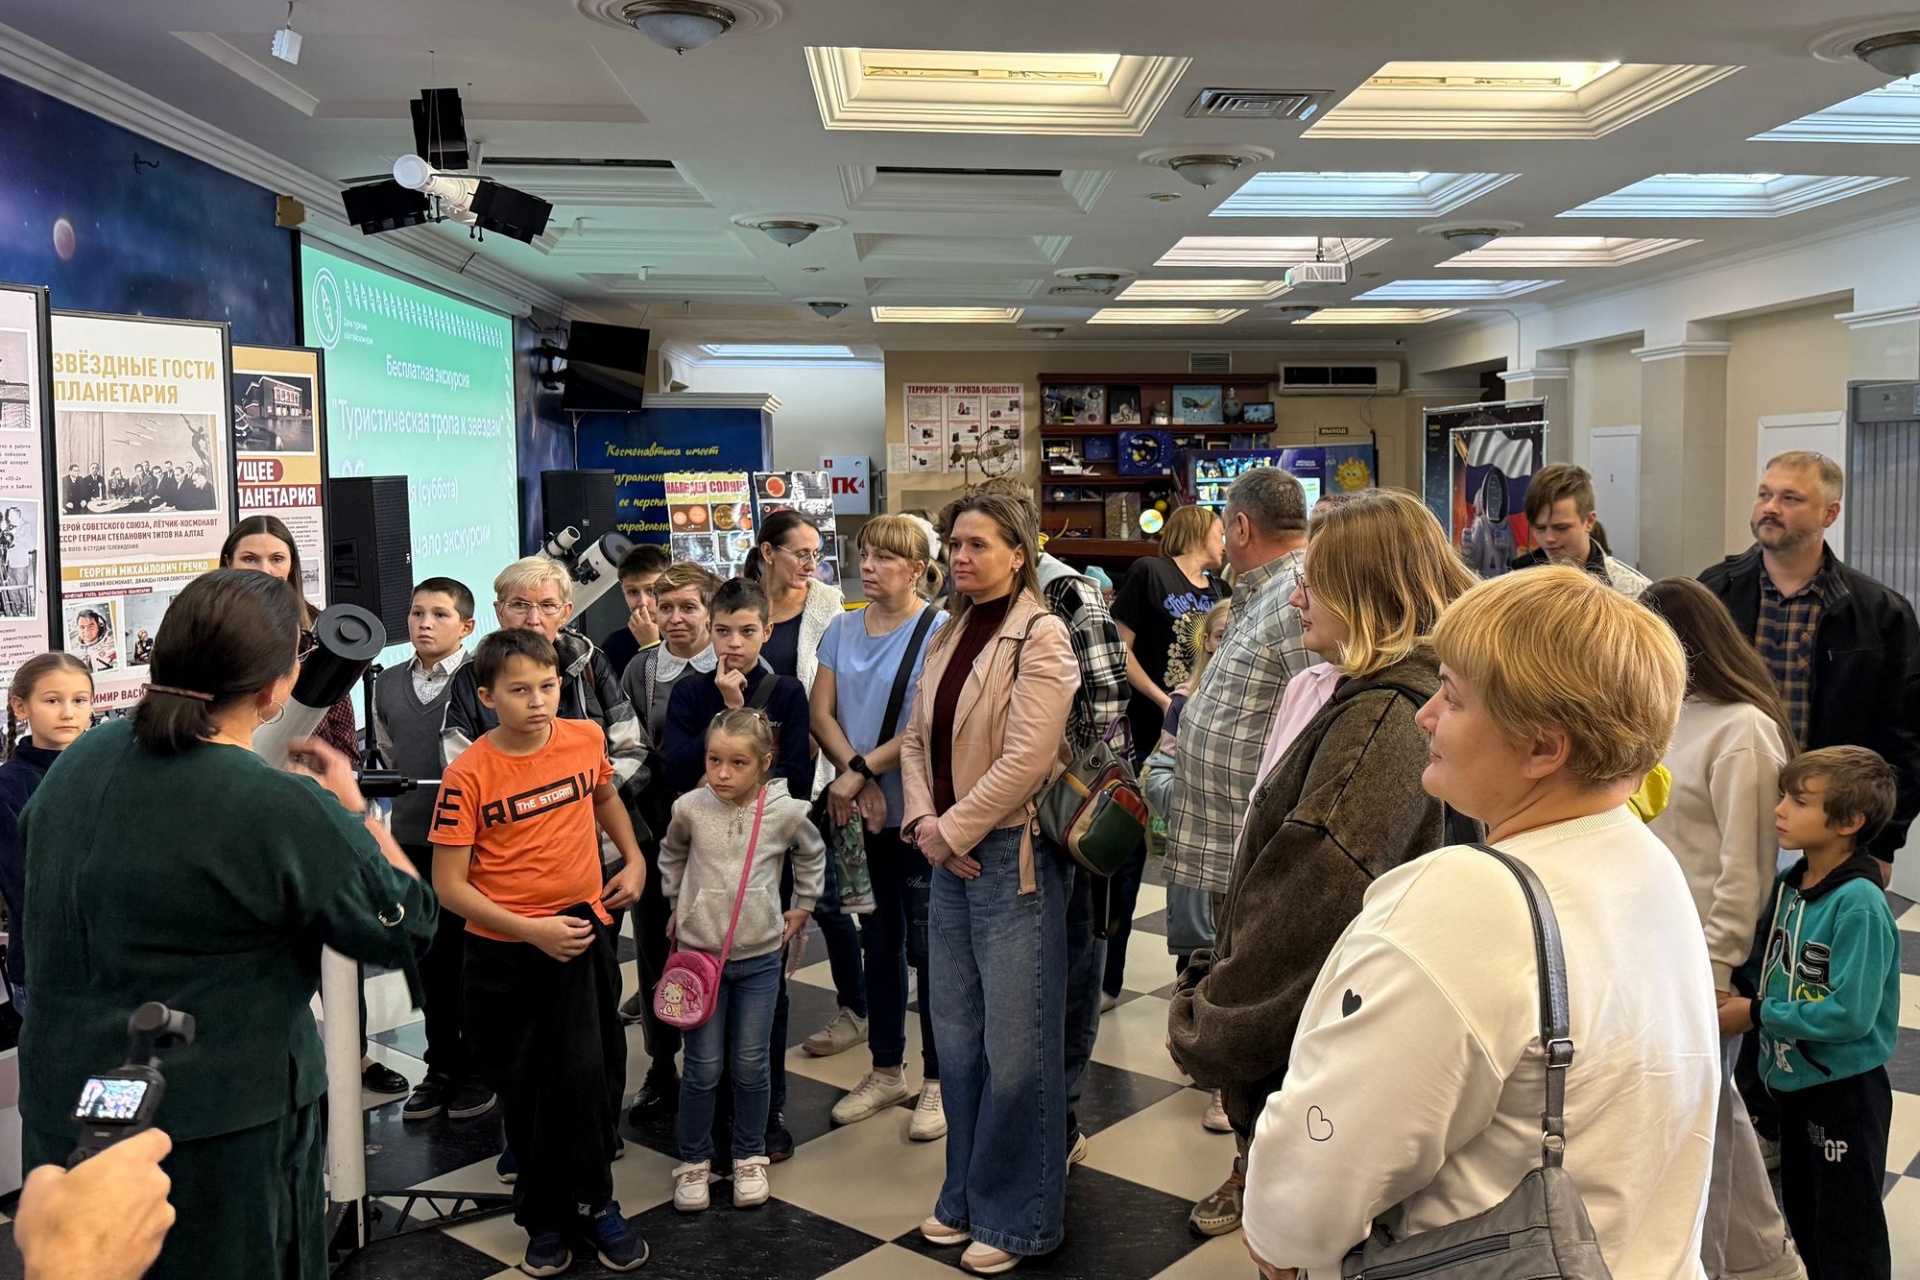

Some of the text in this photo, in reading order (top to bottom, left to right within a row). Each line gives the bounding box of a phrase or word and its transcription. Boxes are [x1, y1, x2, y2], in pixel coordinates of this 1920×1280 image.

[53, 349, 215, 380] ЗВЁЗДНЫЕ ГОСТИ
[386, 354, 470, 391] Бесплатная экскурсия
[53, 380, 178, 405] ПЛАНЕТАРИЯ
[908, 385, 949, 394] ТЕРРОРИЗМ
[954, 385, 980, 394] УГРОЗА
[982, 385, 1020, 394] ОБЩЕСТВУ
[431, 414, 459, 442] тропа
[461, 415, 467, 435] к
[685, 446, 719, 456] имеет
[419, 476, 459, 506] (суббота)
[832, 477, 859, 494] ПК
[82, 521, 125, 531] СОВЕТСКОГО
[126, 520, 152, 530] СОЮЗА,
[59, 529, 204, 543] СССР ГЕРМАН СТЕПАНОВИЧ ТИТОВ НА АЛТАЕ
[443, 524, 491, 557] экскурсии
[80, 560, 208, 578] ГЕОРГИЙ МИХАЙЛОВИЧ ГРЕЧКО
[540, 786, 573, 804] STORM
